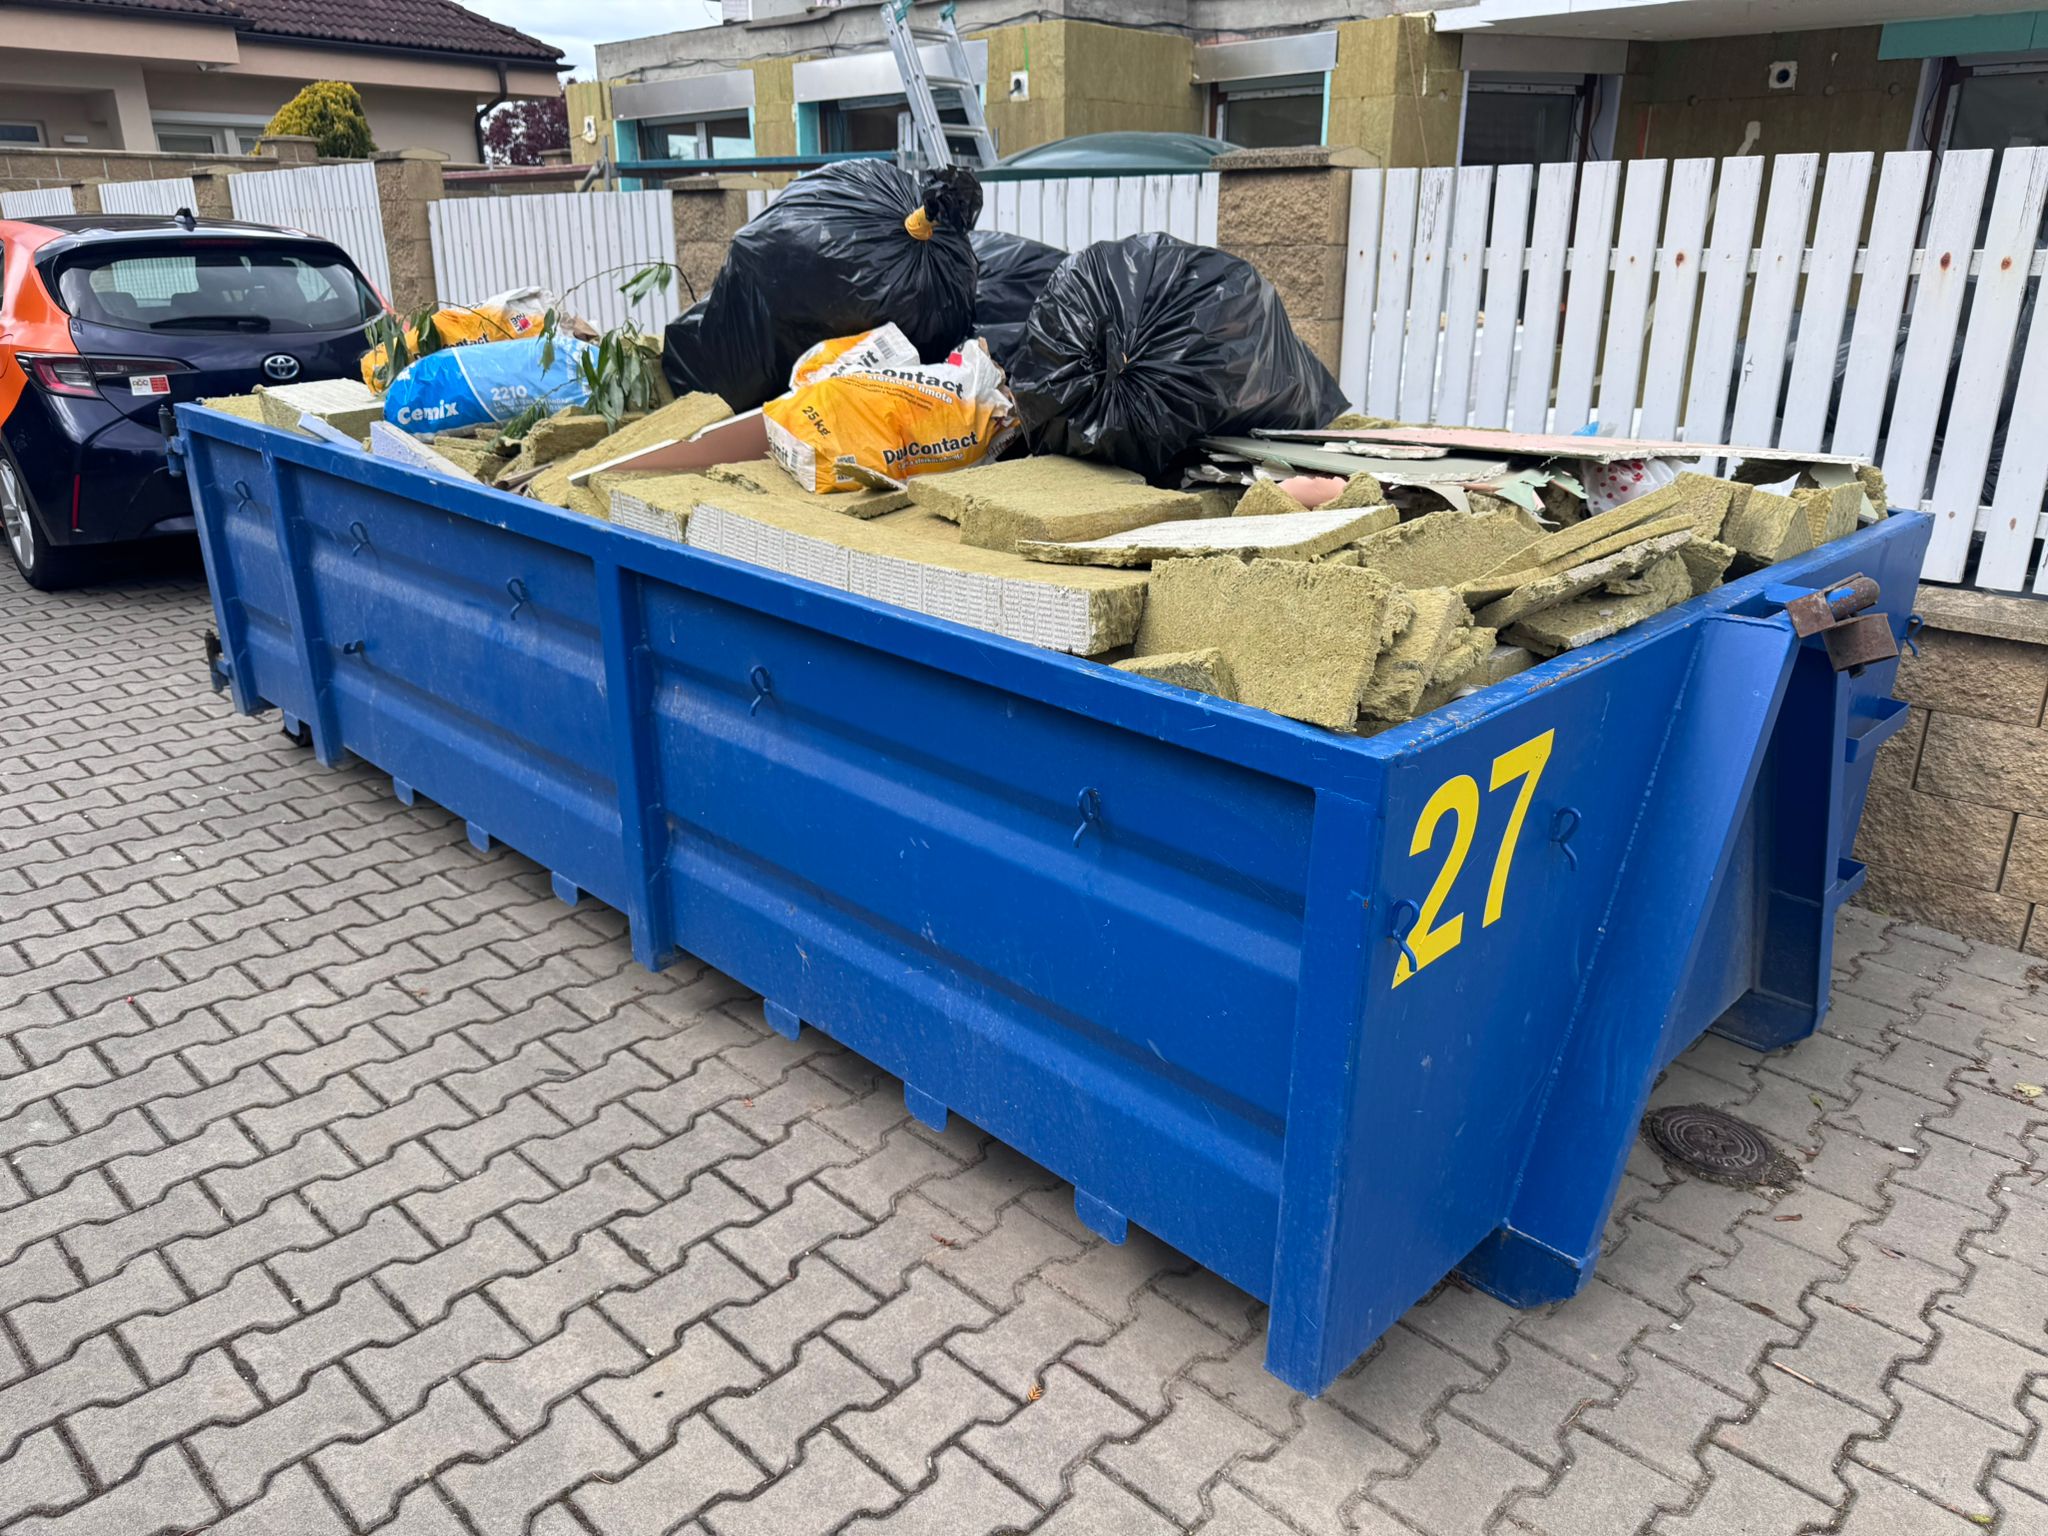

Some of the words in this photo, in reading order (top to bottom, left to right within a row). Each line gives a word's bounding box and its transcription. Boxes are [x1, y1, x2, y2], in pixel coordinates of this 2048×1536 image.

[490, 384, 528, 401] 2210
[397, 399, 460, 425] Cemix
[802, 406, 820, 420] 25
[813, 419, 831, 436] kg
[1391, 728, 1555, 989] 27
